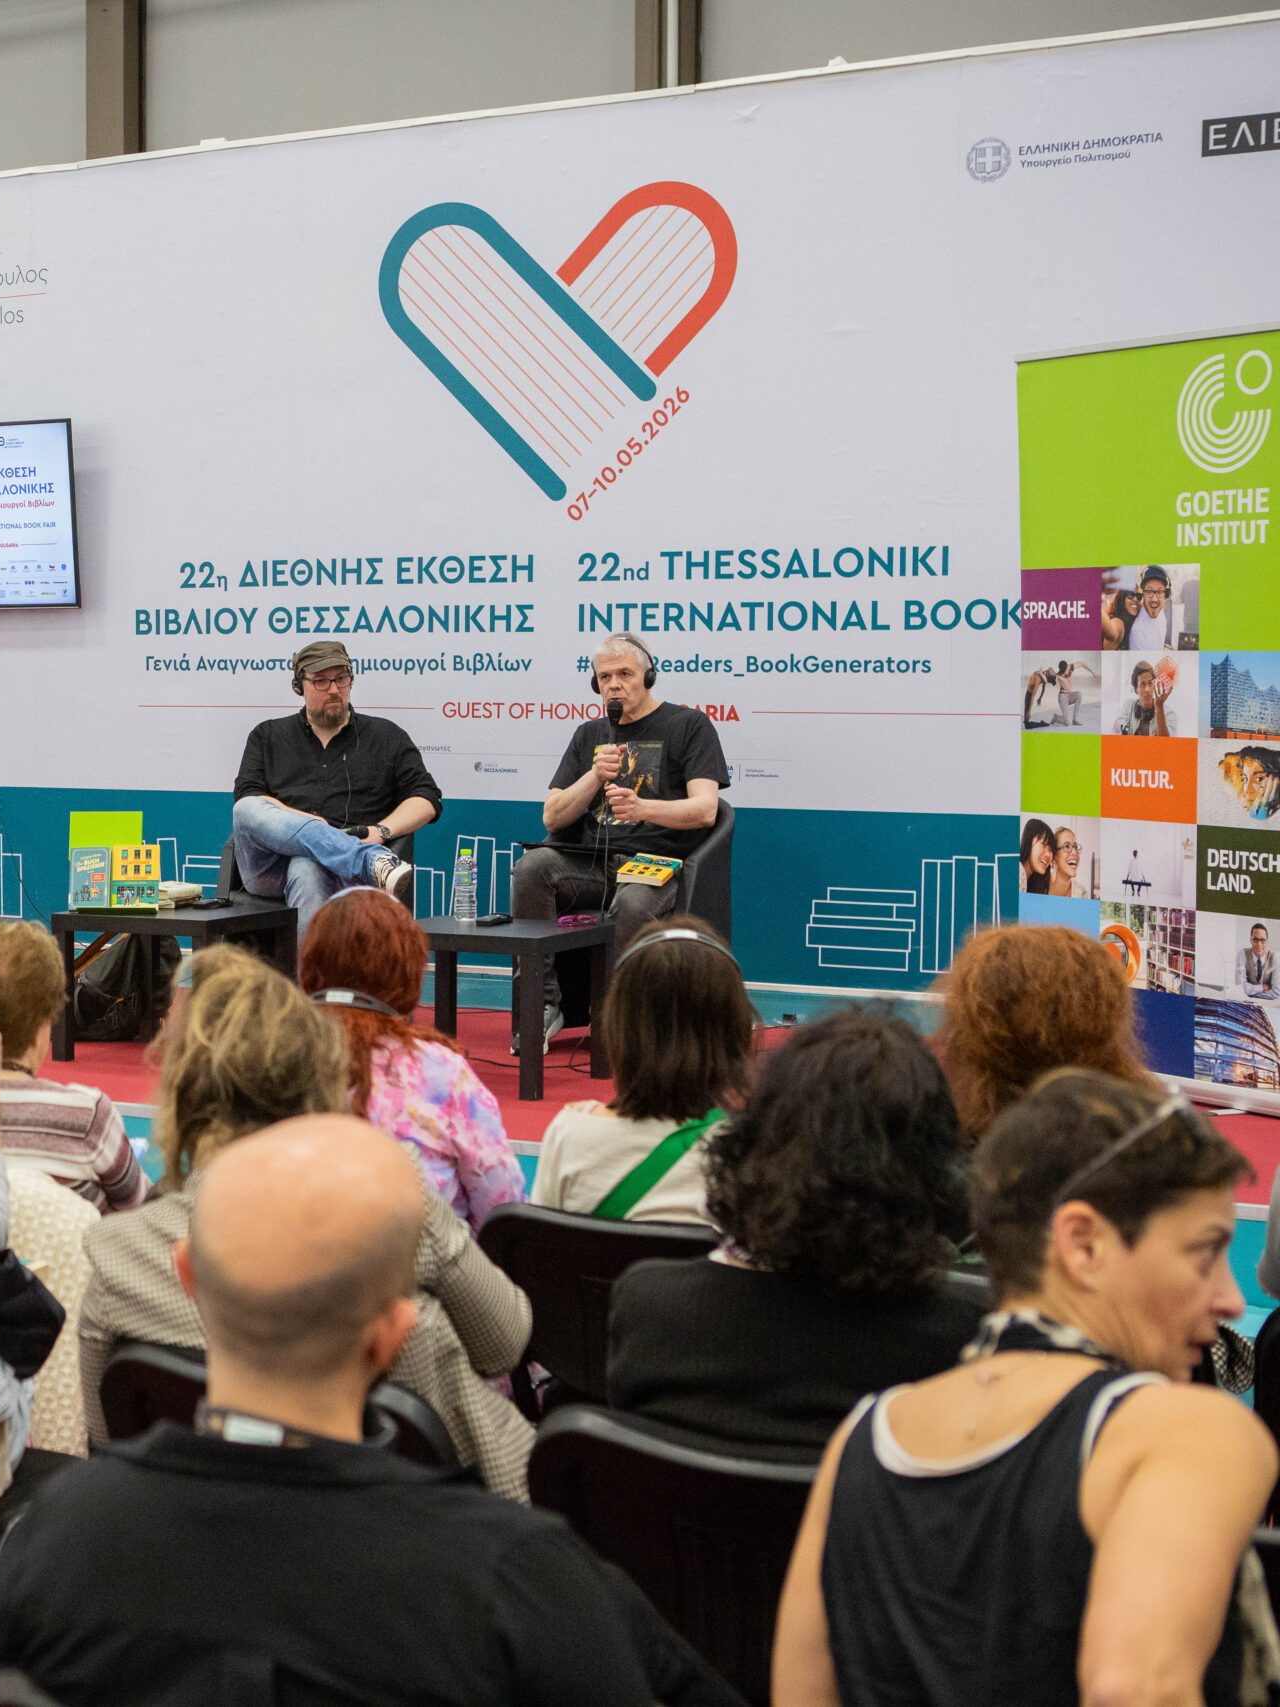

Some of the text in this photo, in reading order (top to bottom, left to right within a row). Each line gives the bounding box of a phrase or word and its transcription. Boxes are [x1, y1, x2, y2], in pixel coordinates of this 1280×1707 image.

[1018, 131, 1163, 156] ΕΛΛΗΝΙΚΗ ΔΗΜΟΚΡΑΤΙΑ
[1019, 149, 1131, 169] Υπουργείο Πολιτισμού
[1176, 487, 1270, 517] GOETHE
[1176, 519, 1270, 547] INSTITUT
[179, 554, 535, 592] 22η ΔΙΕΘΝΗΣ ΕΚΘΕΣΗ
[577, 545, 951, 583] 22nd THESSALONIKI
[135, 603, 535, 636] ΒΙΒΛΙΟΥ ΘΕΣΣΑΛΟΝΙΚΗΣ
[577, 598, 1021, 633] INTERNATIONAL BOOK
[1023, 600, 1090, 619] SPRACHE.
[145, 653, 191, 672] Γενιά
[349, 653, 447, 676] ημιουργοί
[453, 652, 533, 676] Βιβλίων
[442, 701, 505, 719] GUEST
[508, 702, 536, 720] OF
[1111, 768, 1174, 790] KULTUR.
[1207, 871, 1255, 895] LAND.
